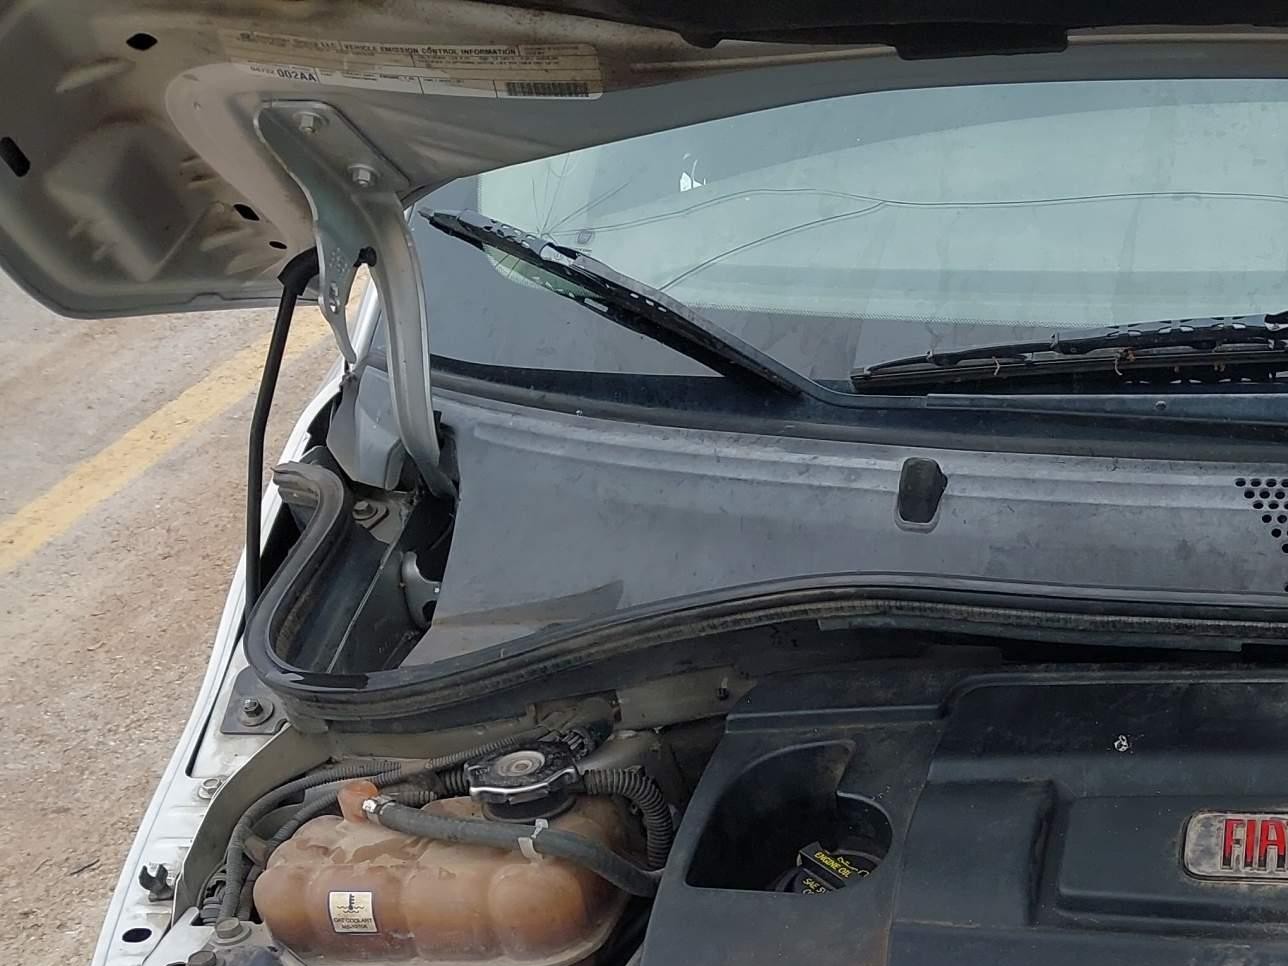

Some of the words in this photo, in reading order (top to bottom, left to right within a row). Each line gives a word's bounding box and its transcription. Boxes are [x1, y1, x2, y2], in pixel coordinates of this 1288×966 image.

[422, 46, 457, 55] CONTROL
[461, 48, 516, 56] INFORMATION
[276, 68, 317, 82] 002AA
[814, 851, 841, 871] ENGINE
[838, 867, 853, 878] OIL
